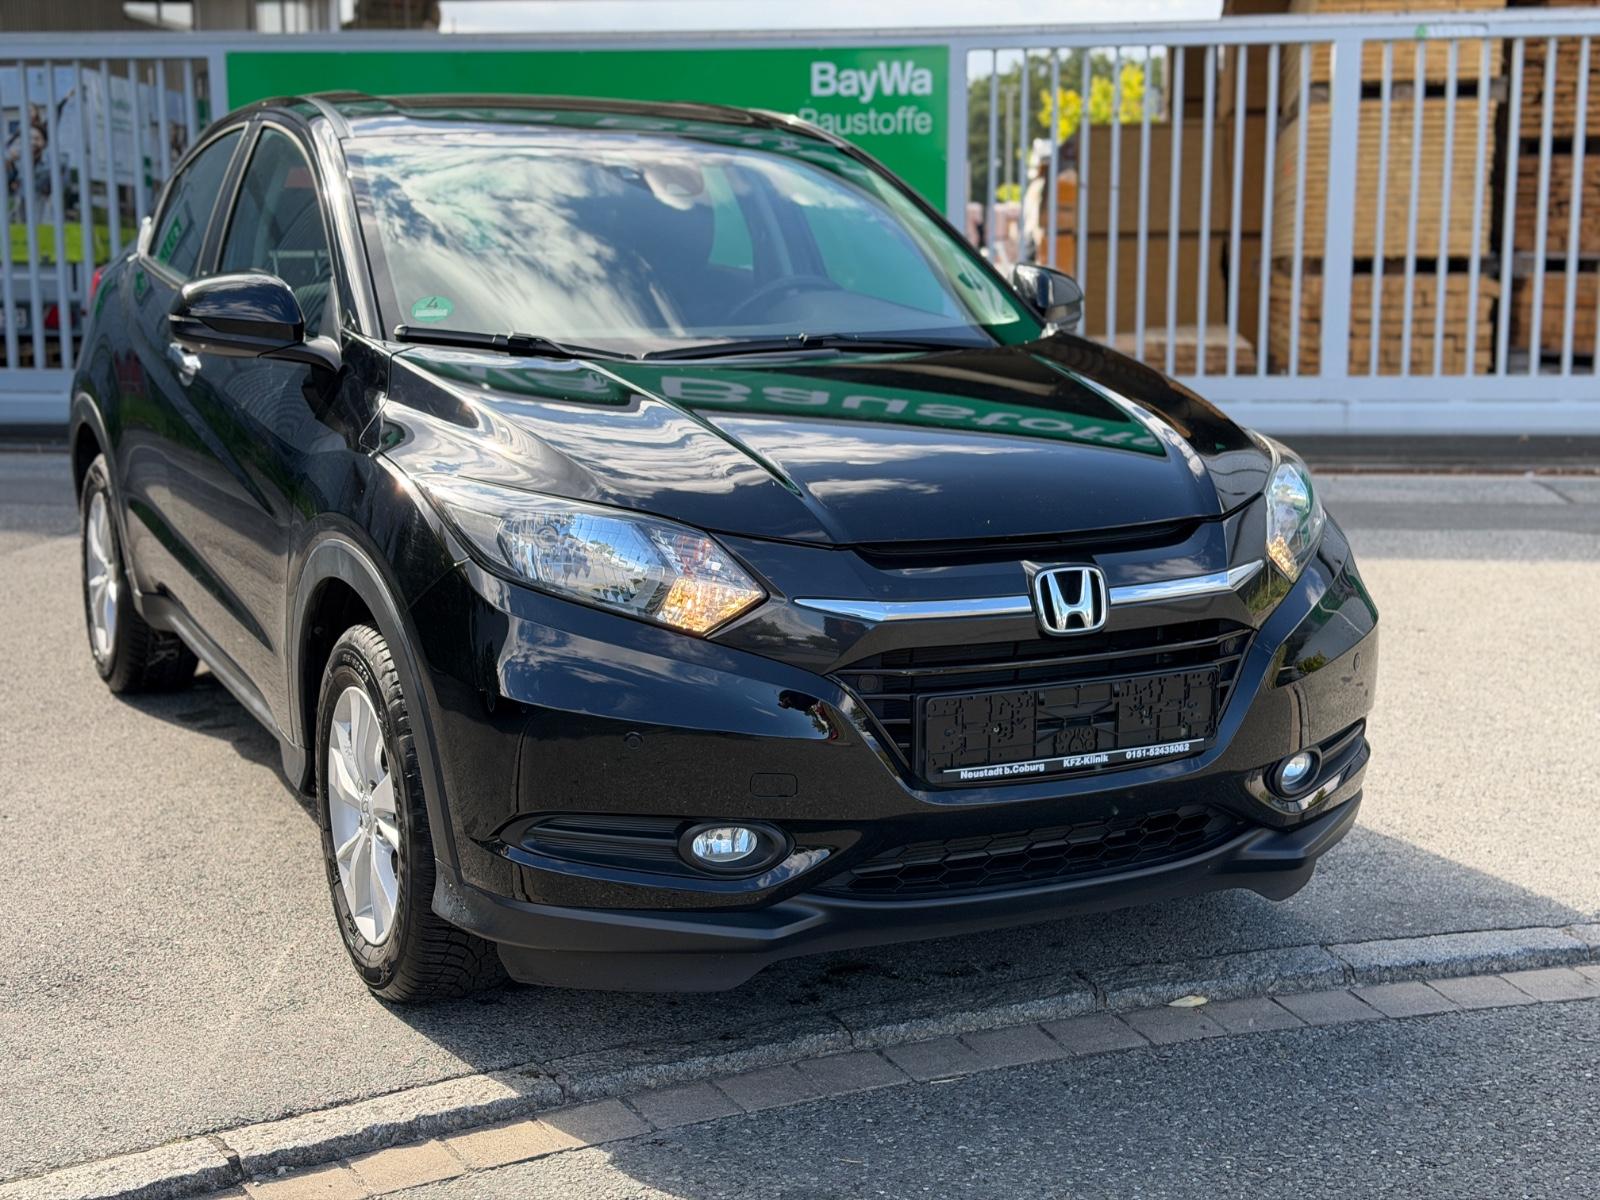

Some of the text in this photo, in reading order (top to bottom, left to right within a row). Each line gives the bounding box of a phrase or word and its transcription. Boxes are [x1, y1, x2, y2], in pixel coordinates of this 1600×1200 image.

[810, 60, 933, 104] BayWa
[425, 296, 439, 309] 4
[960, 768, 1003, 780] Neustadt
[1063, 753, 1109, 768] KFZ-Klinik
